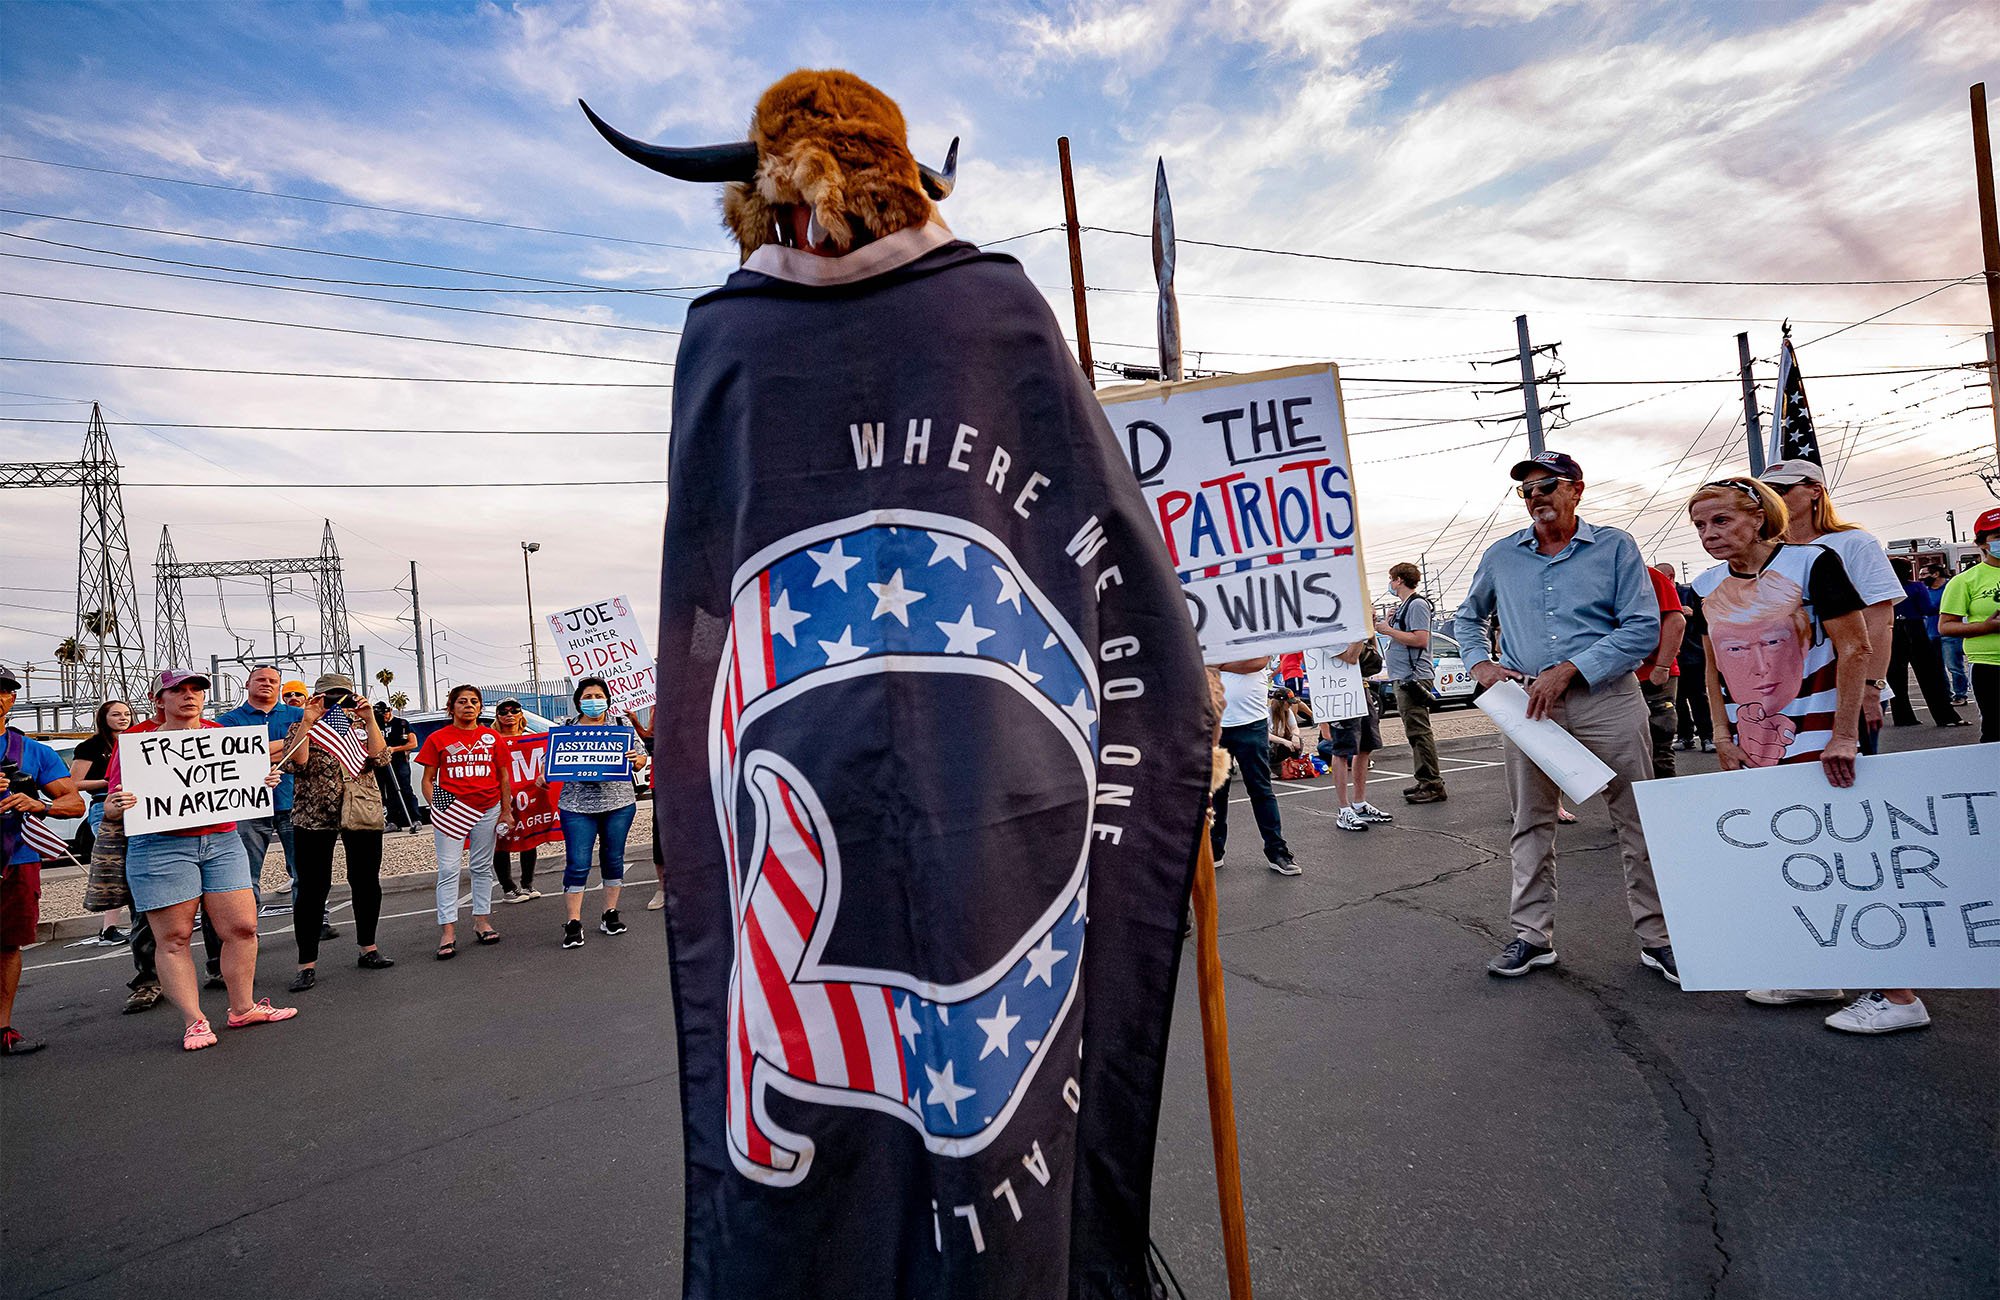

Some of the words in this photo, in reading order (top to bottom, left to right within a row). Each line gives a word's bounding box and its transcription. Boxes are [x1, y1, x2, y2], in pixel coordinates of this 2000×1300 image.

[1202, 396, 1322, 462] THE
[849, 418, 1051, 519] WHERE
[1157, 458, 1355, 567] PATRIOTS
[1065, 515, 1124, 601] WE
[1216, 570, 1342, 632] WINS
[564, 602, 613, 631] JOE
[584, 627, 598, 635] AND
[568, 629, 620, 650] HUNTER
[566, 639, 639, 677] BIDEN
[1100, 635, 1145, 701] GO
[1306, 648, 1350, 670] STO
[607, 667, 655, 696] RRUPT
[1320, 675, 1347, 688] the
[610, 695, 627, 705] ALS
[630, 689, 648, 697] WITH
[624, 693, 656, 710] UKRAIN
[1314, 691, 1367, 718] STEAL
[140, 735, 215, 765] FREE
[221, 735, 266, 755] OUR
[446, 753, 492, 763] ASSYRIANS
[556, 741, 624, 751] ASSYRIANS
[557, 755, 580, 763] FOR
[582, 754, 621, 763] TRUMP
[173, 760, 239, 787] VOTE
[145, 796, 172, 820] IN
[179, 786, 270, 817] ARIZONA
[1091, 743, 1142, 846] ONE
[526, 811, 561, 828] GREA
[1716, 791, 1998, 849] COUNT
[1782, 844, 1948, 892] OUR
[1792, 900, 2000, 950] VOTE
